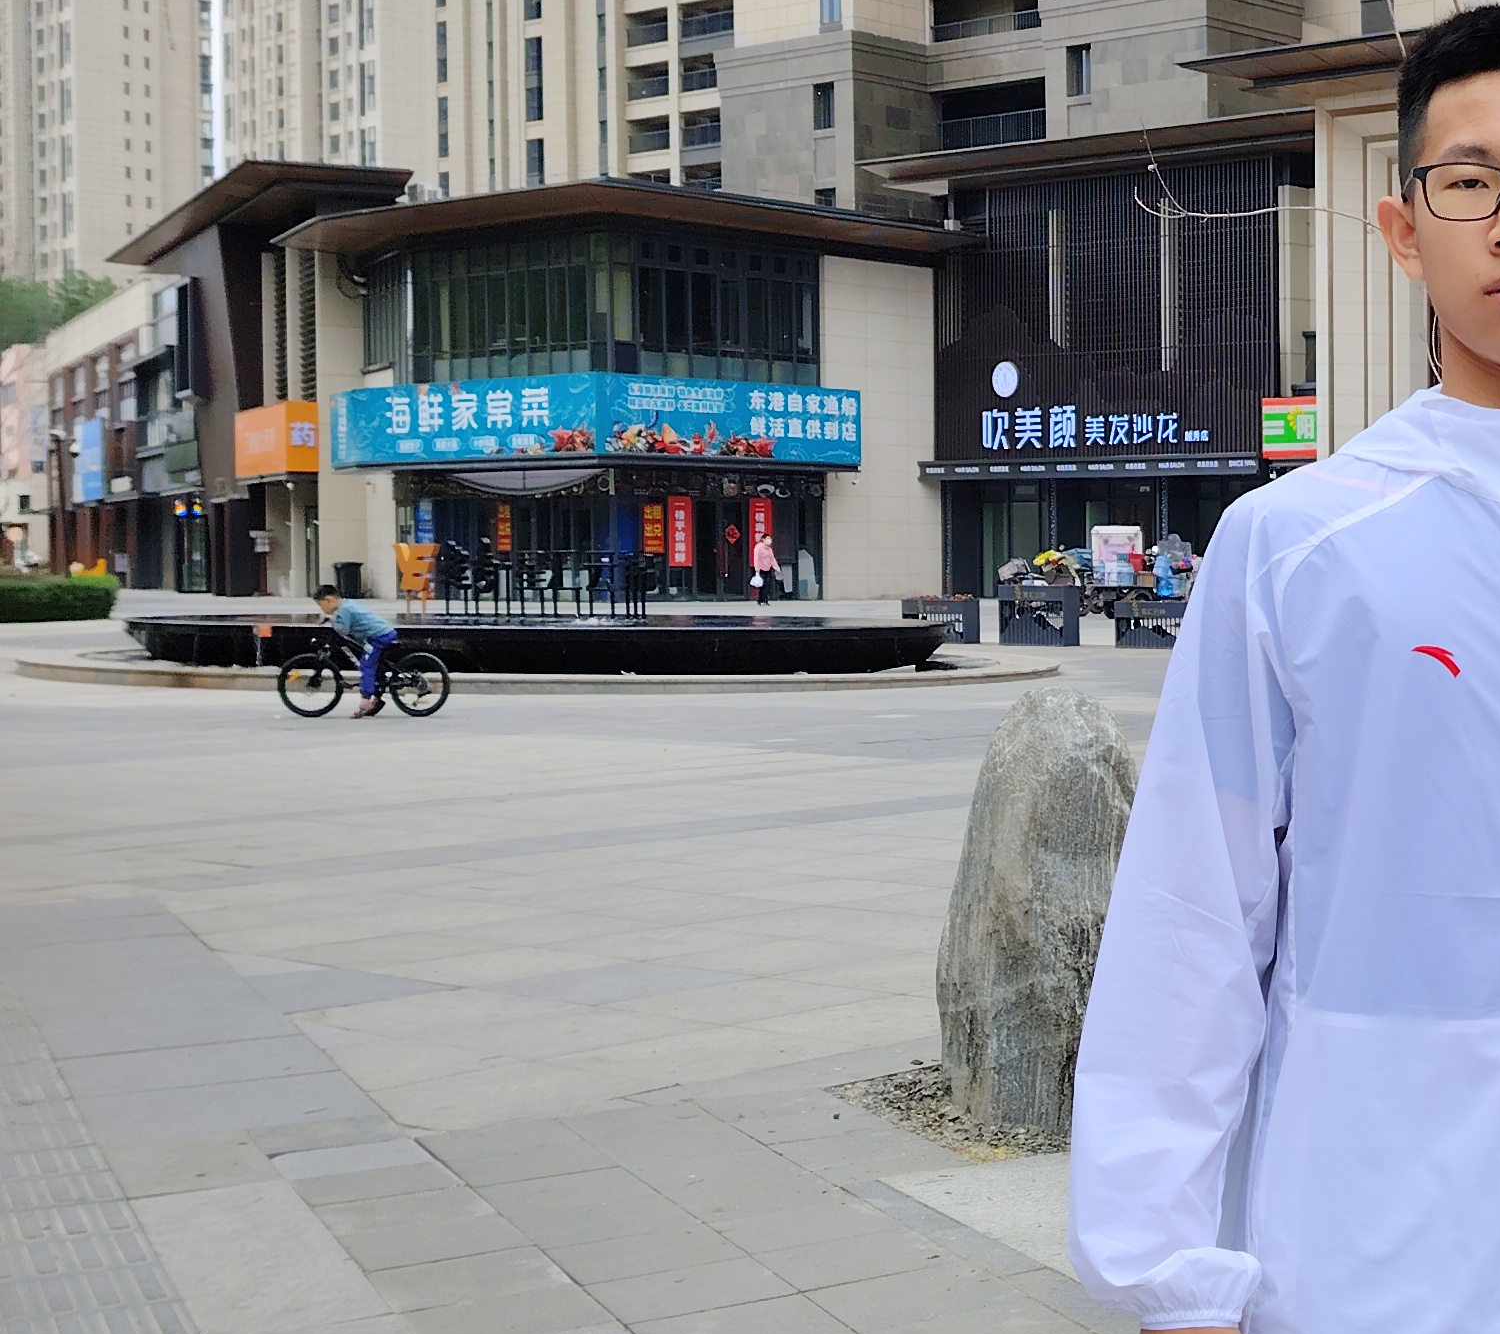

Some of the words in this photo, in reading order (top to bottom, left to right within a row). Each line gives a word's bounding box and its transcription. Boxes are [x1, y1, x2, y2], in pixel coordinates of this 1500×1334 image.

[385, 387, 549, 434] 海鲜家常菜
[749, 390, 857, 416] 东港自家渔船
[289, 421, 317, 447] 药
[749, 417, 857, 442] 鲜活直供到店
[981, 404, 1077, 450] 吹美颜
[1084, 412, 1180, 446] 美发沙龙
